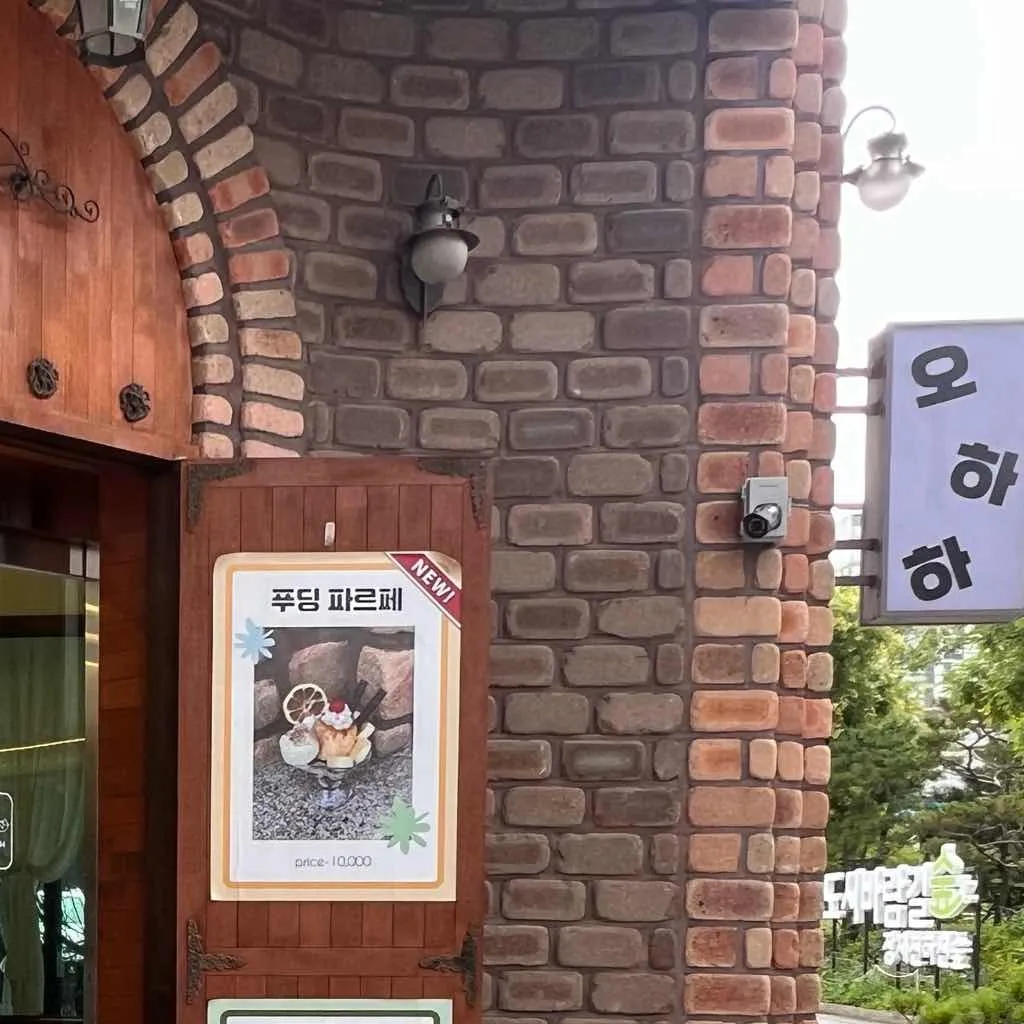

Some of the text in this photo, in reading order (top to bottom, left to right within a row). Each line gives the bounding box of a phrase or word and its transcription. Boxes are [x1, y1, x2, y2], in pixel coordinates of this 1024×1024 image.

[902, 345, 1019, 602] 오하하
[271, 587, 403, 613] 푸딩 파르페
[410, 558, 456, 603] NEW!
